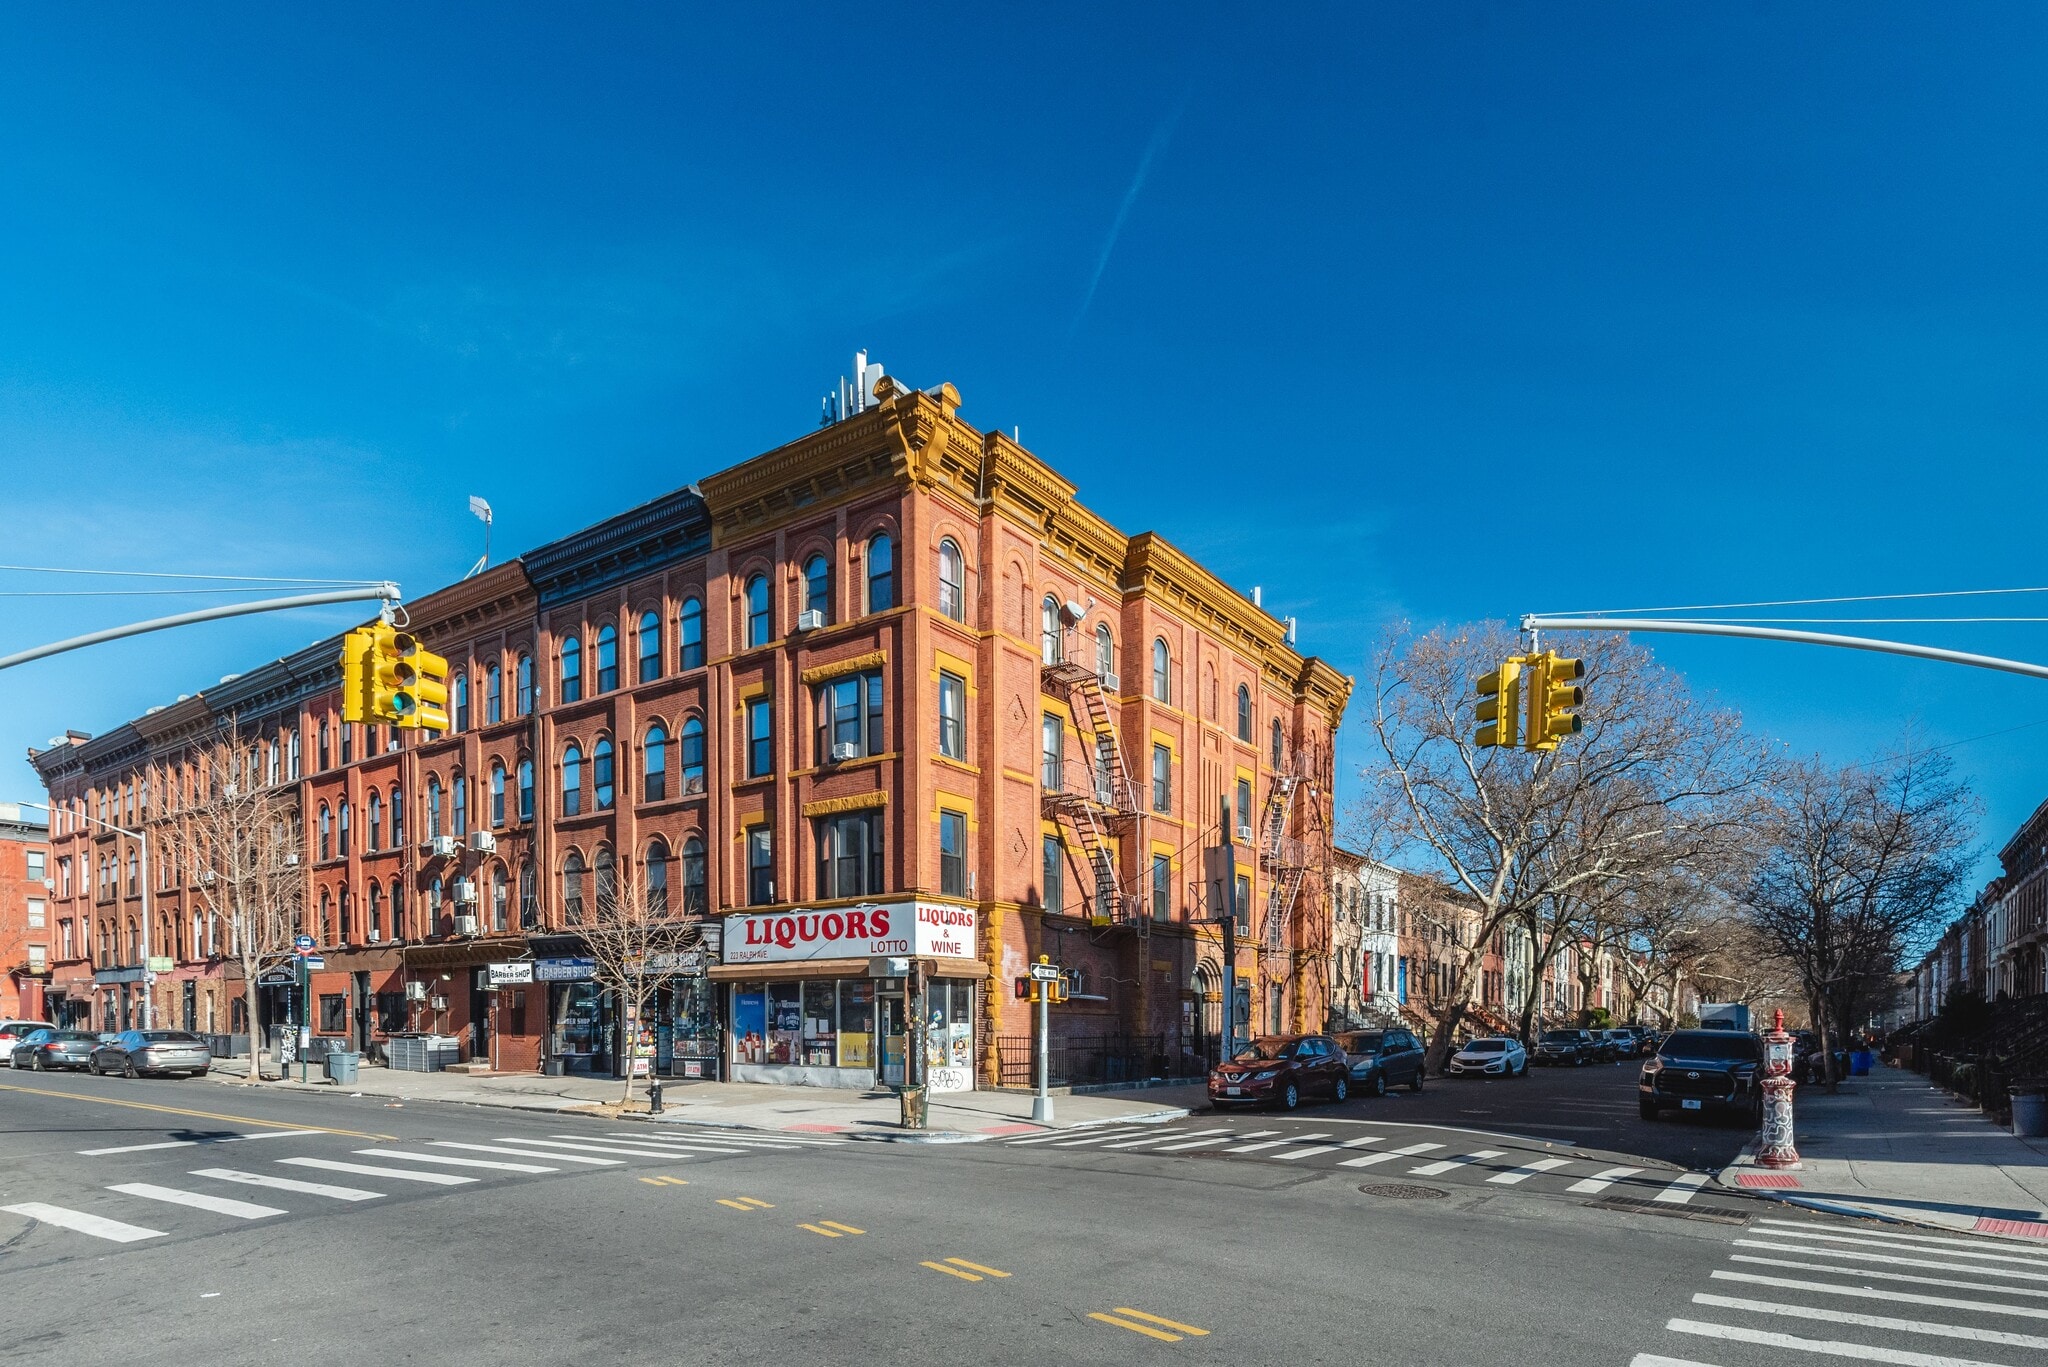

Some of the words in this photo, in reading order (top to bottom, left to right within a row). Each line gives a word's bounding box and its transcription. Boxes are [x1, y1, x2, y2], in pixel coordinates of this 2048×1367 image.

[918, 907, 973, 926] LIQUORS
[745, 909, 890, 949] LIQUORS
[943, 928, 949, 938] &
[870, 939, 908, 953] LOTTO
[931, 940, 962, 954] WINE
[729, 951, 739, 960] 223
[739, 950, 757, 959] RALPH
[490, 969, 514, 979] BARBER
[514, 968, 531, 978] SHOP
[544, 965, 573, 979] BARBER
[573, 964, 594, 978] SHOP
